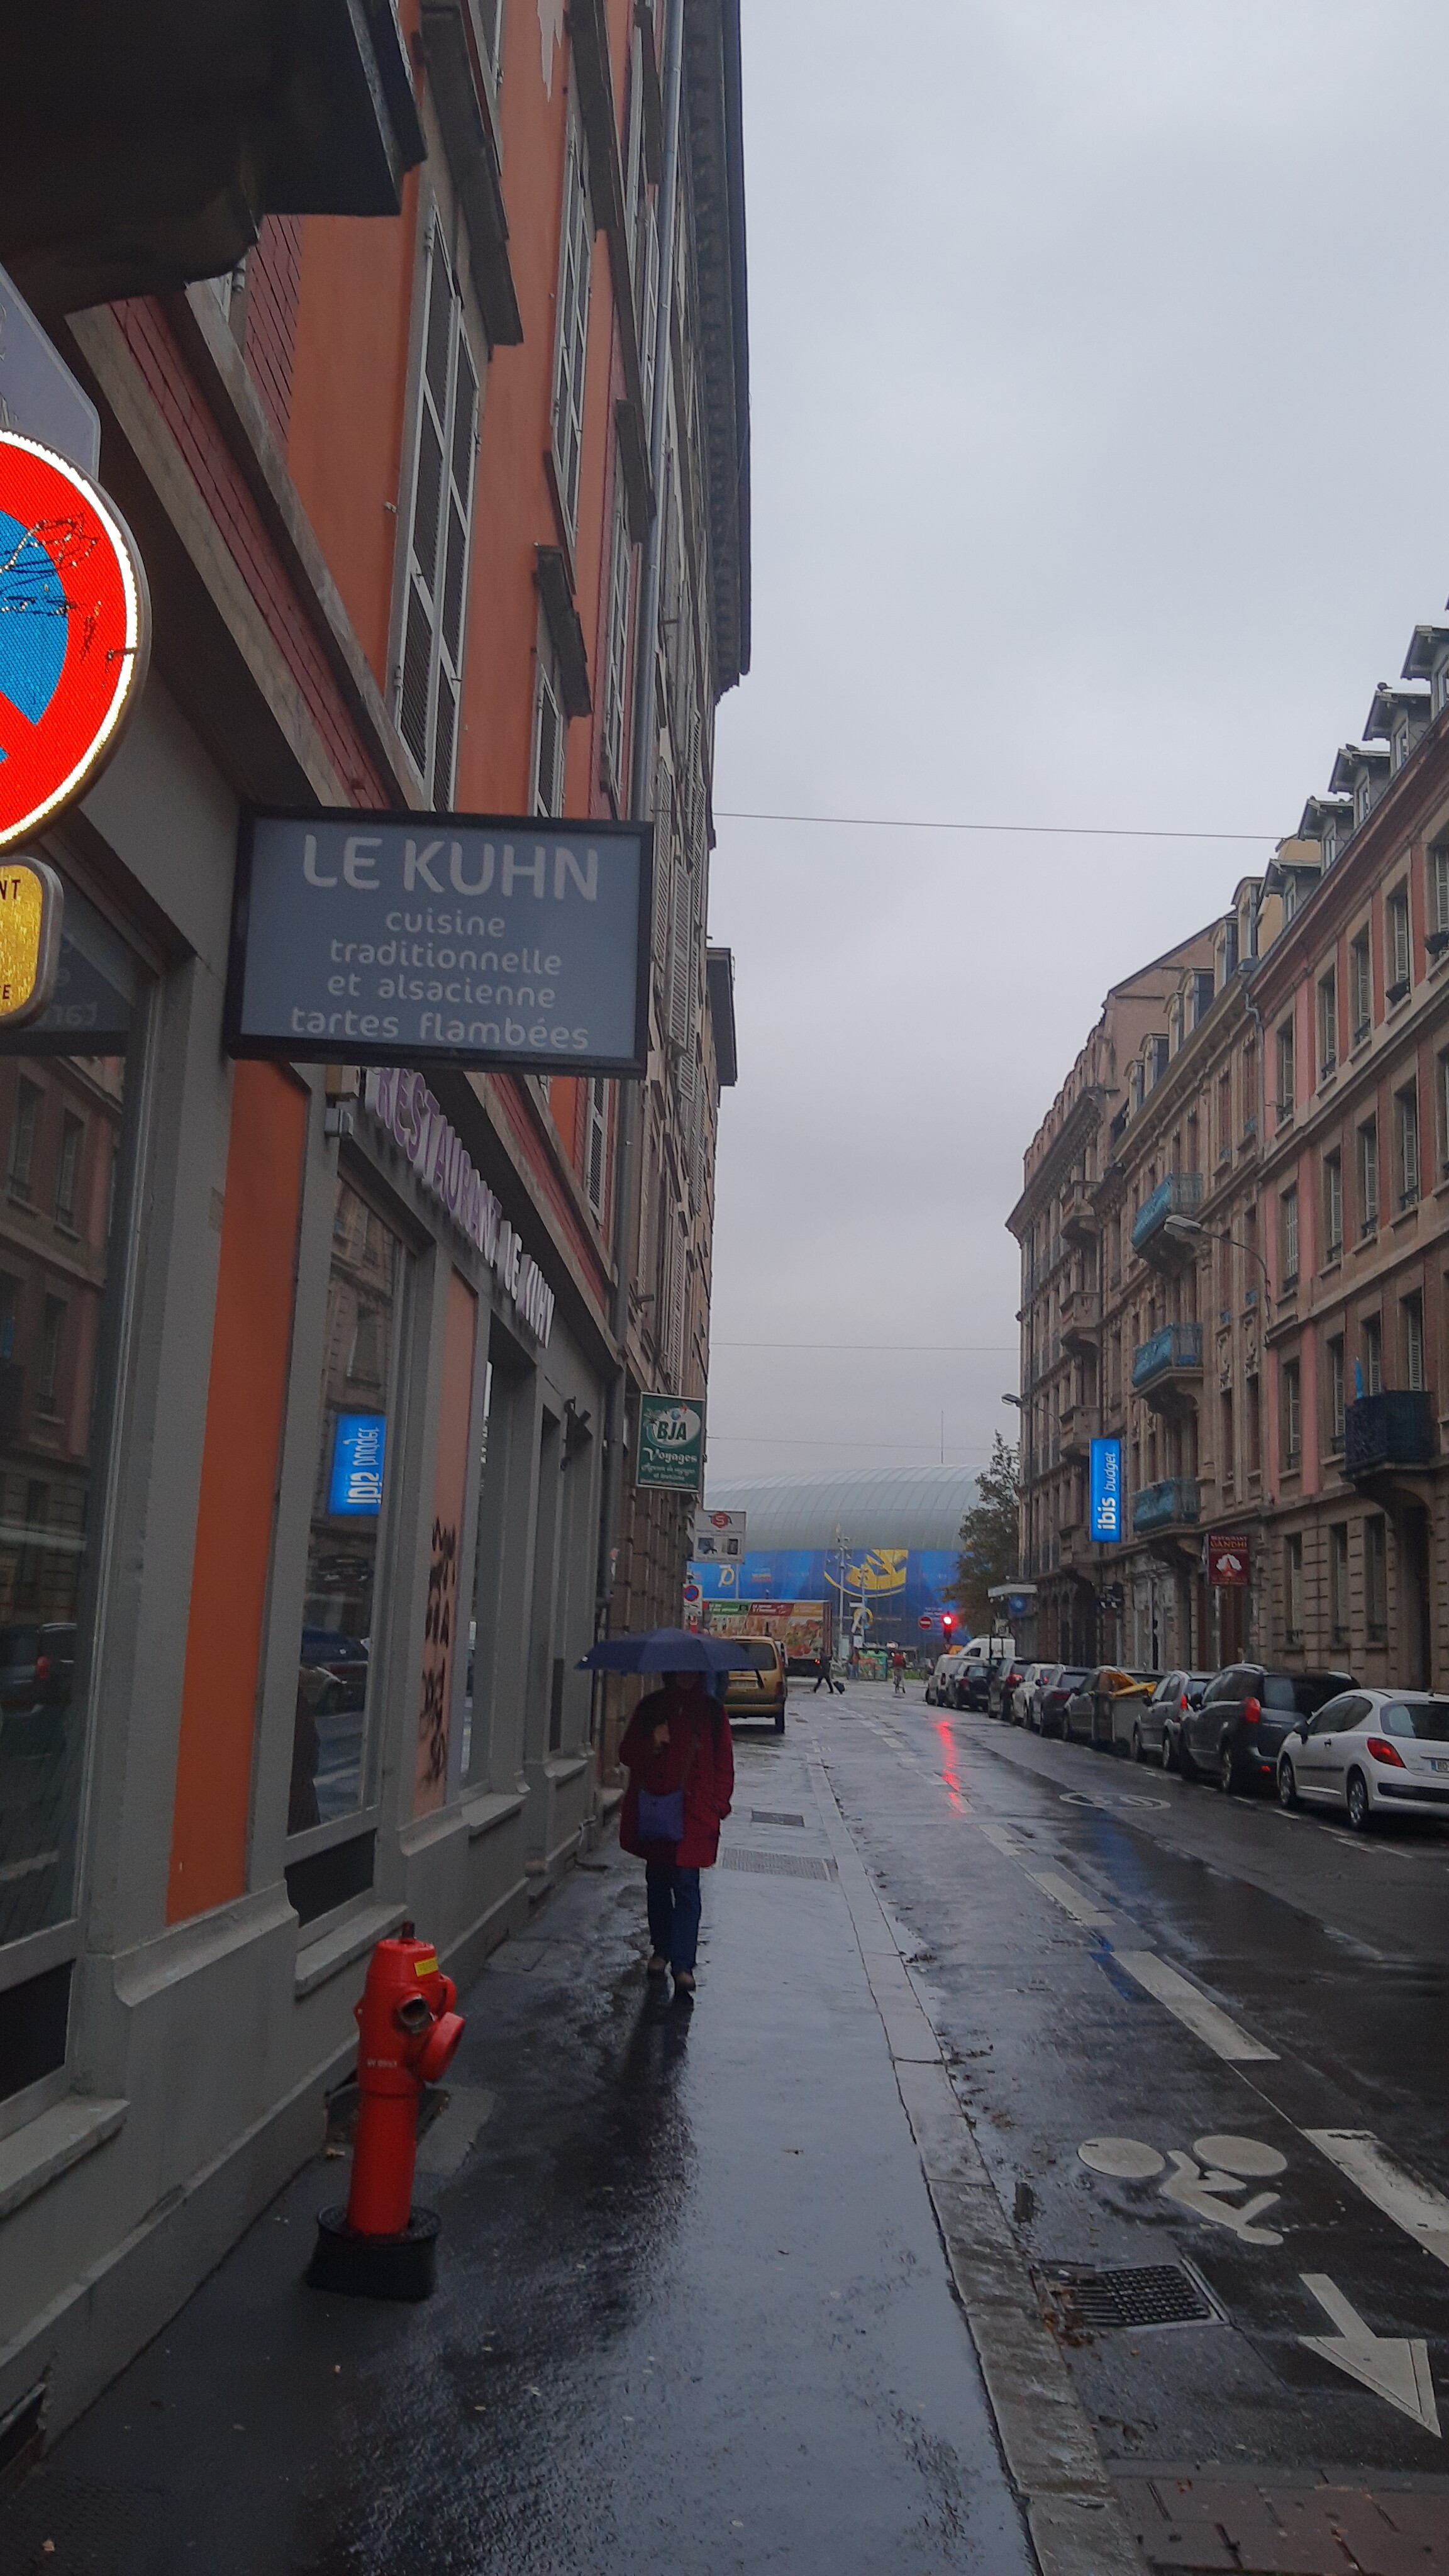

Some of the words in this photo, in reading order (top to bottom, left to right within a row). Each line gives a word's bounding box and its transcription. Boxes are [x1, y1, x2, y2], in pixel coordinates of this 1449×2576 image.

[303, 834, 382, 889] LE
[402, 838, 598, 901] KUHN
[386, 908, 505, 938] cuisine
[331, 939, 561, 975] traditionnelle
[328, 973, 361, 997] et
[379, 974, 555, 1008] alsacienne
[291, 1007, 399, 1038] tartes
[419, 1011, 589, 1050] flambées
[657, 1421, 687, 1440] BJA
[643, 1447, 697, 1465] Voyages
[1104, 1452, 1119, 1492] budget
[1097, 1497, 1116, 1530] ibis
